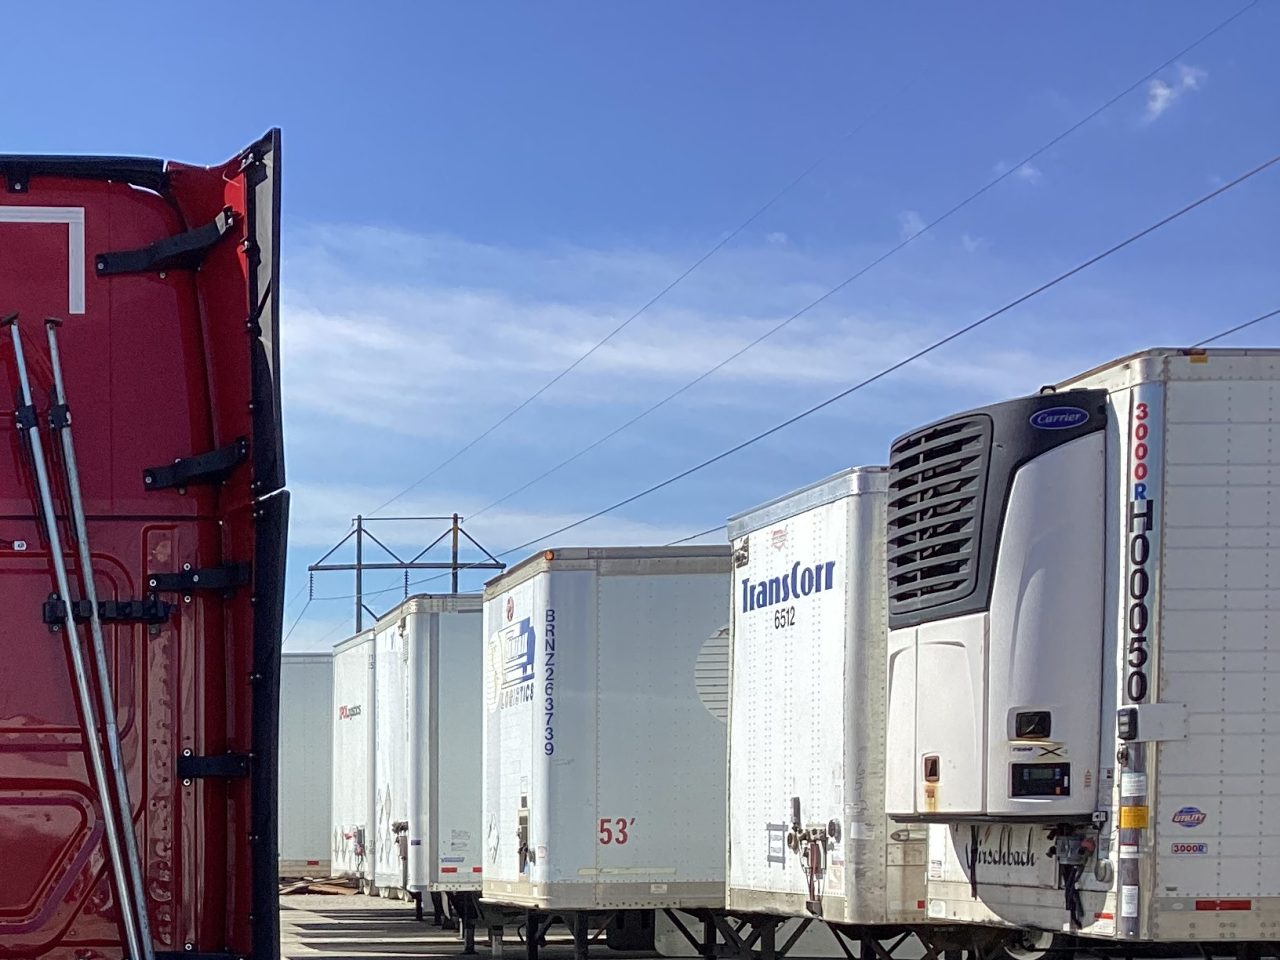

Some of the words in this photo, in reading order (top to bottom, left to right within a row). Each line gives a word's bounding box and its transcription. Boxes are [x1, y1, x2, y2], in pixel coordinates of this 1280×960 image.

[1037, 412, 1082, 424] Carrier
[1133, 402, 1149, 500] 3000R
[742, 560, 836, 614] TransCorr
[774, 605, 796, 630] 6512
[544, 609, 556, 756] BRNZ263739
[1173, 813, 1206, 823] UTILITY
[1173, 844, 1205, 853] 3000R
